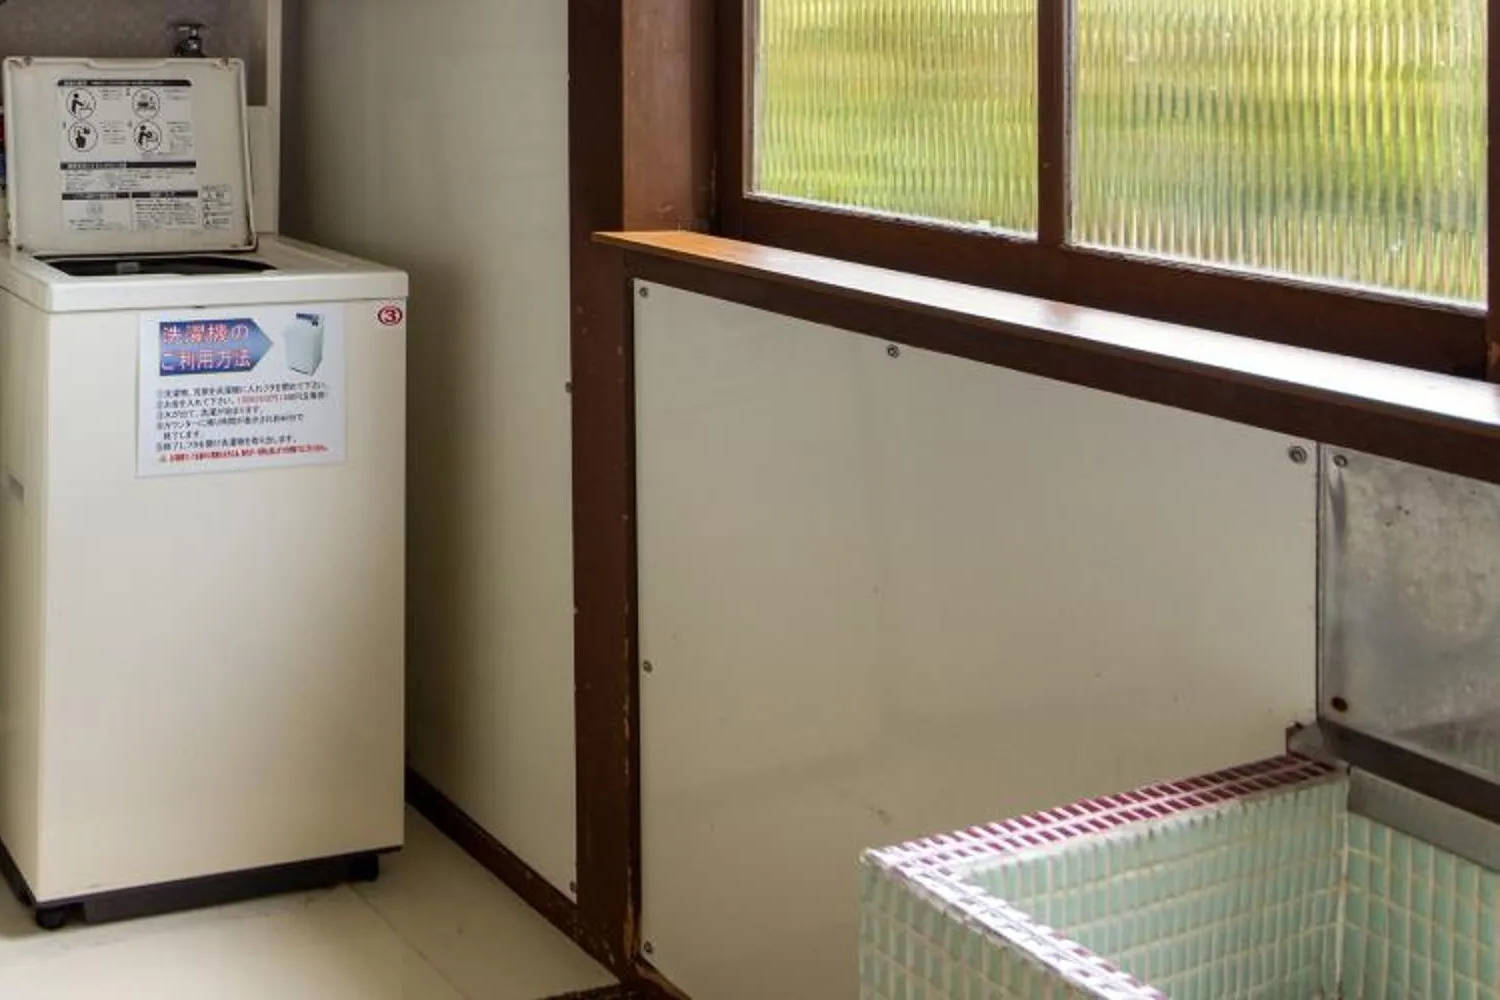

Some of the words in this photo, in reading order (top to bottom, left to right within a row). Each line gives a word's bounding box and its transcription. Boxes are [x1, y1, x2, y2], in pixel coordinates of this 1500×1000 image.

[163, 323, 249, 345] 洗濯機の
[162, 349, 251, 371] ご利用方法
